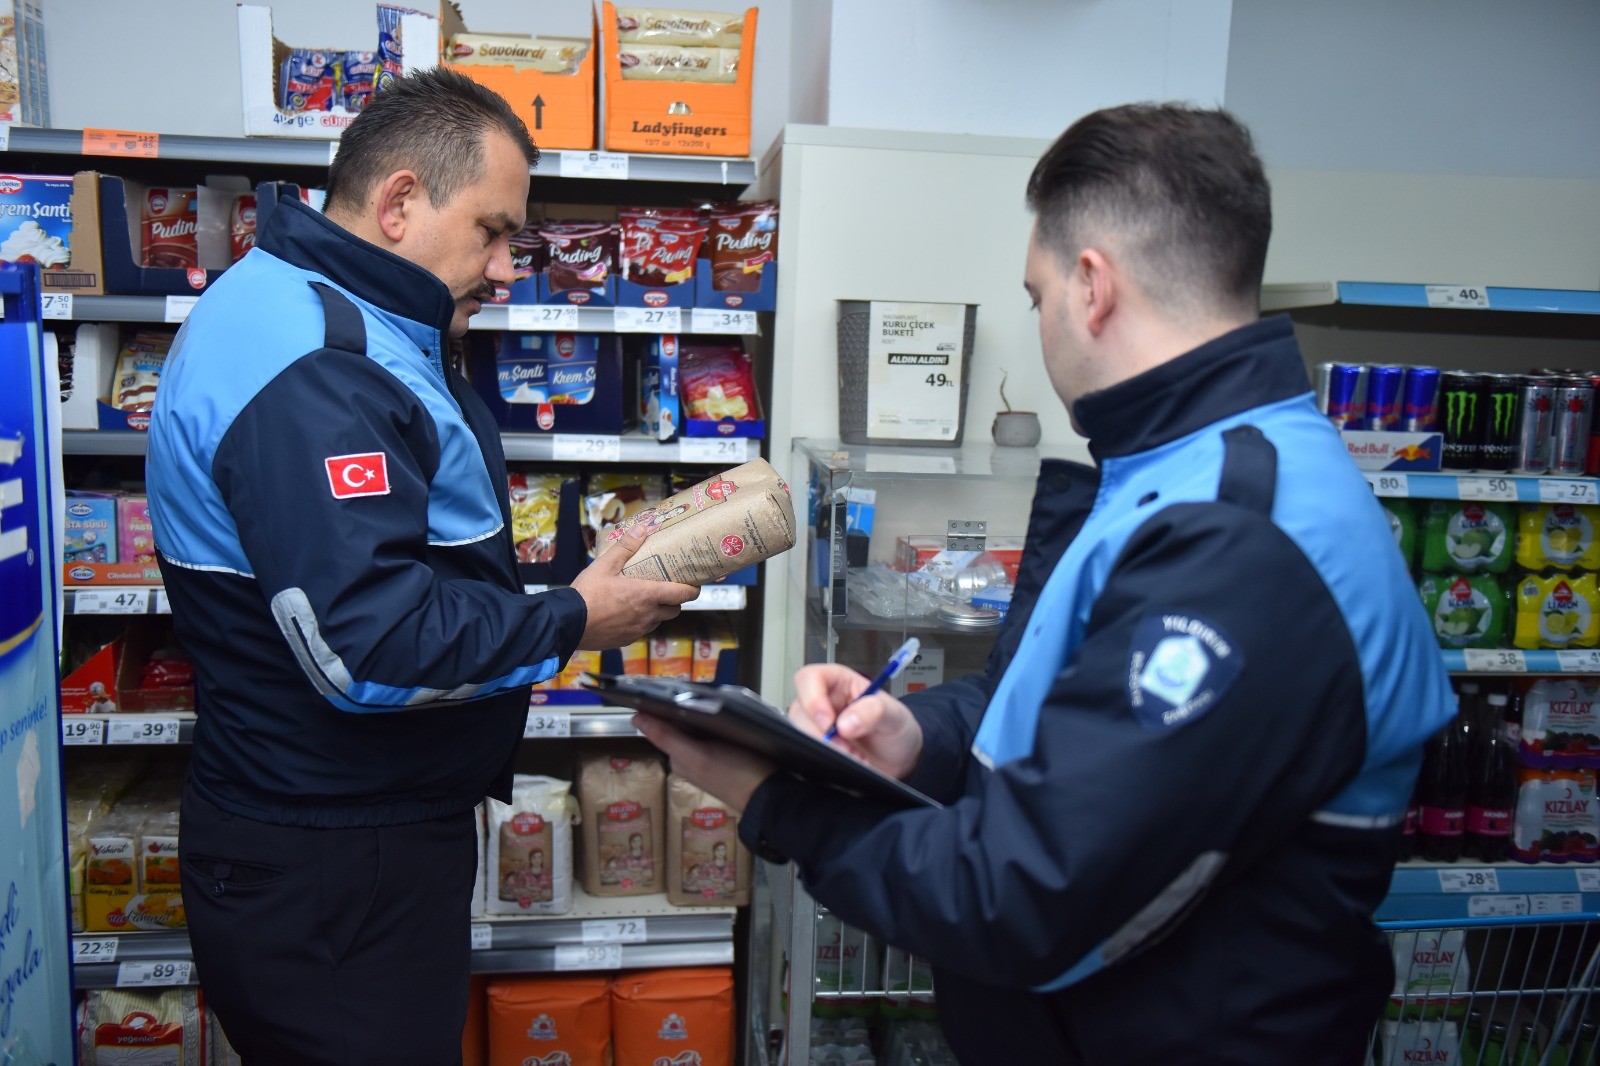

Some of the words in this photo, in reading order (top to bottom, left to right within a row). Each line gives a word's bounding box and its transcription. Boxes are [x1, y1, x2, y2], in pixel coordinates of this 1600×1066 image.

[480, 42, 546, 60] Savoiardi
[632, 121, 727, 137] Ladyfingers
[0, 202, 30, 216] rem
[152, 219, 198, 240] Pudin
[716, 232, 773, 250] Puding
[549, 244, 602, 264] Puding
[1460, 289, 1478, 300] 40
[909, 320, 935, 329] ÇİÇEK
[890, 356, 917, 364] ALDIN
[918, 356, 947, 364] ALDIN!
[512, 364, 544, 382] Şanti
[553, 370, 584, 384] Krem
[926, 374, 946, 386] 49
[718, 442, 737, 454] 24
[1347, 443, 1367, 454] Red
[1368, 443, 1389, 454] Bull
[1380, 478, 1399, 488] 80
[1489, 480, 1507, 492] 50
[1570, 485, 1588, 496] 27
[115, 594, 137, 606] 47
[710, 588, 730, 601] 62
[1500, 654, 1517, 665] 38
[1550, 702, 1594, 714] KIZILAY
[65, 722, 100, 736] 19,90
[143, 722, 178, 736] 39,95
[1545, 800, 1589, 814] KIZILAY
[618, 923, 637, 934] 72
[79, 942, 115, 955] 22,50
[153, 964, 189, 978] 89,50
[117, 1035, 157, 1044] yeğenler
